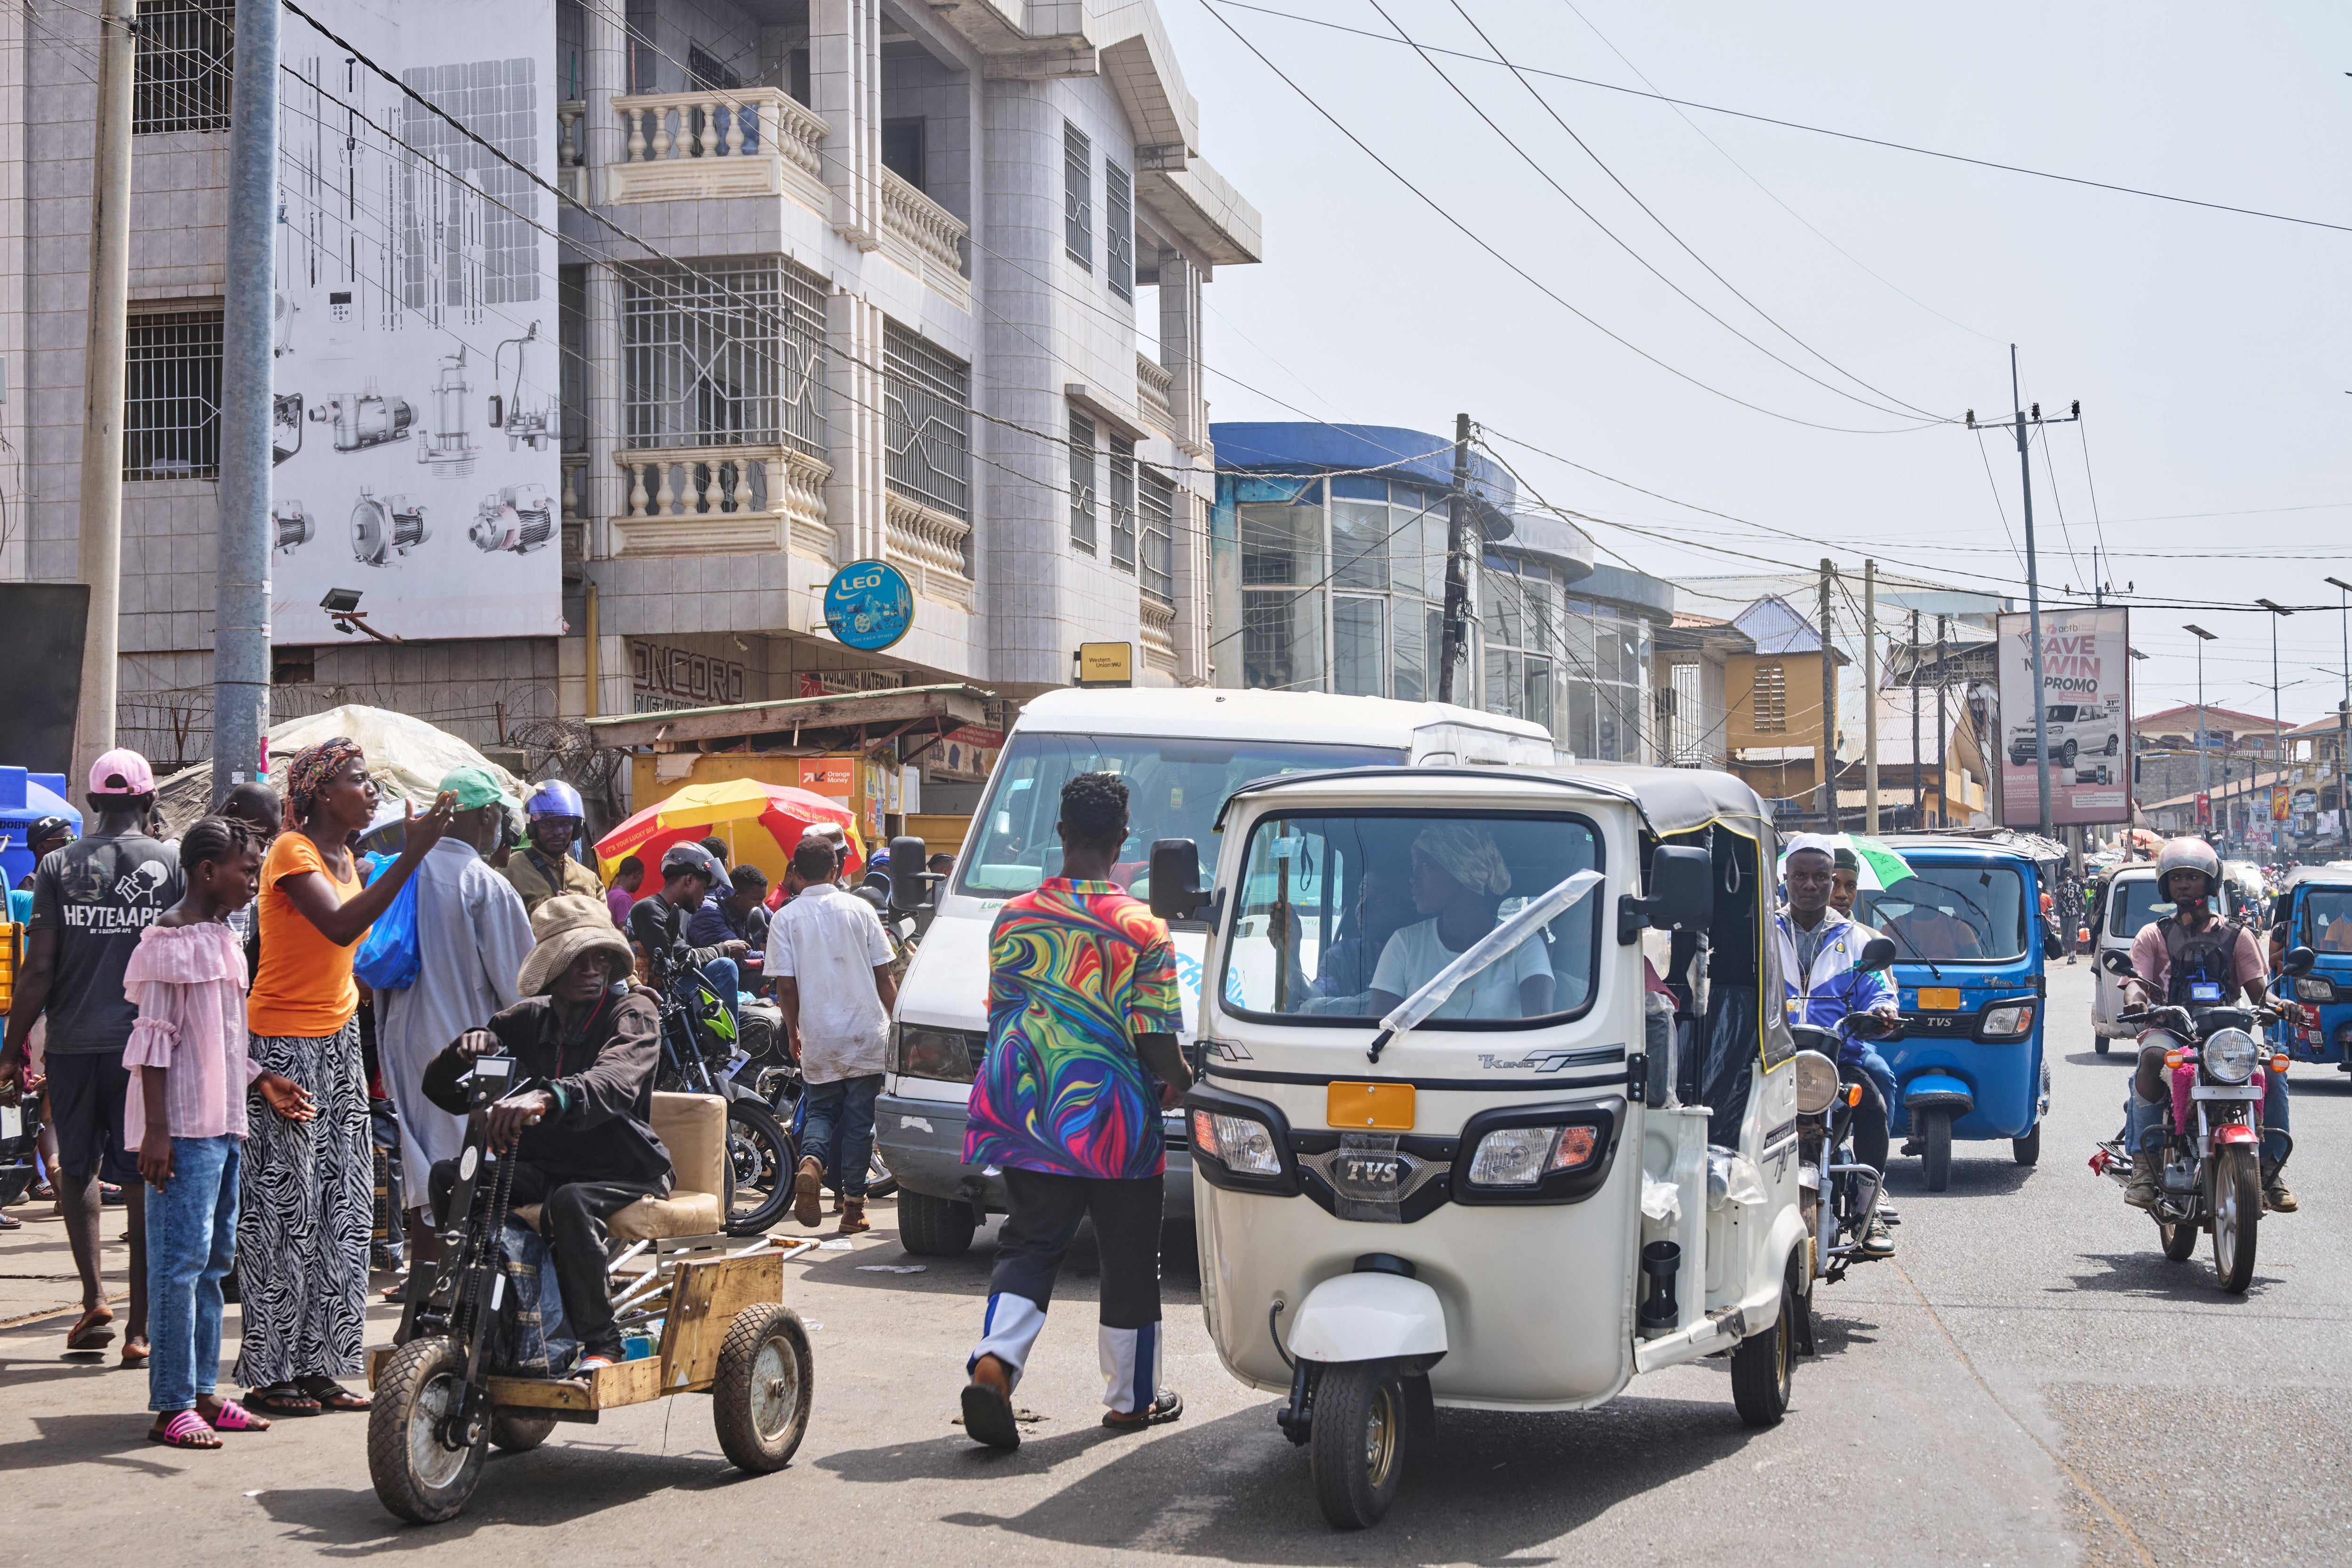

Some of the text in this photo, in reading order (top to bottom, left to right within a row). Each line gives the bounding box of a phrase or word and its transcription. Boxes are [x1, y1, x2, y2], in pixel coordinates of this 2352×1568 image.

[842, 575, 881, 590] LEO
[2058, 623, 2078, 633] actb
[2042, 656, 2100, 681] WIN
[2044, 677, 2098, 693] PROMO
[796, 809, 811, 818] YOUR
[812, 813, 830, 823] LUCKY
[606, 826, 654, 853] IT'S YOUR LUCKY DAY
[63, 905, 163, 927] HEYTEAAPE
[1927, 1018, 1952, 1027] TVS
[1483, 1060, 1535, 1068] KING
[1766, 1132, 1782, 1147] DELUXE
[1347, 1161, 1398, 1182] TVS
